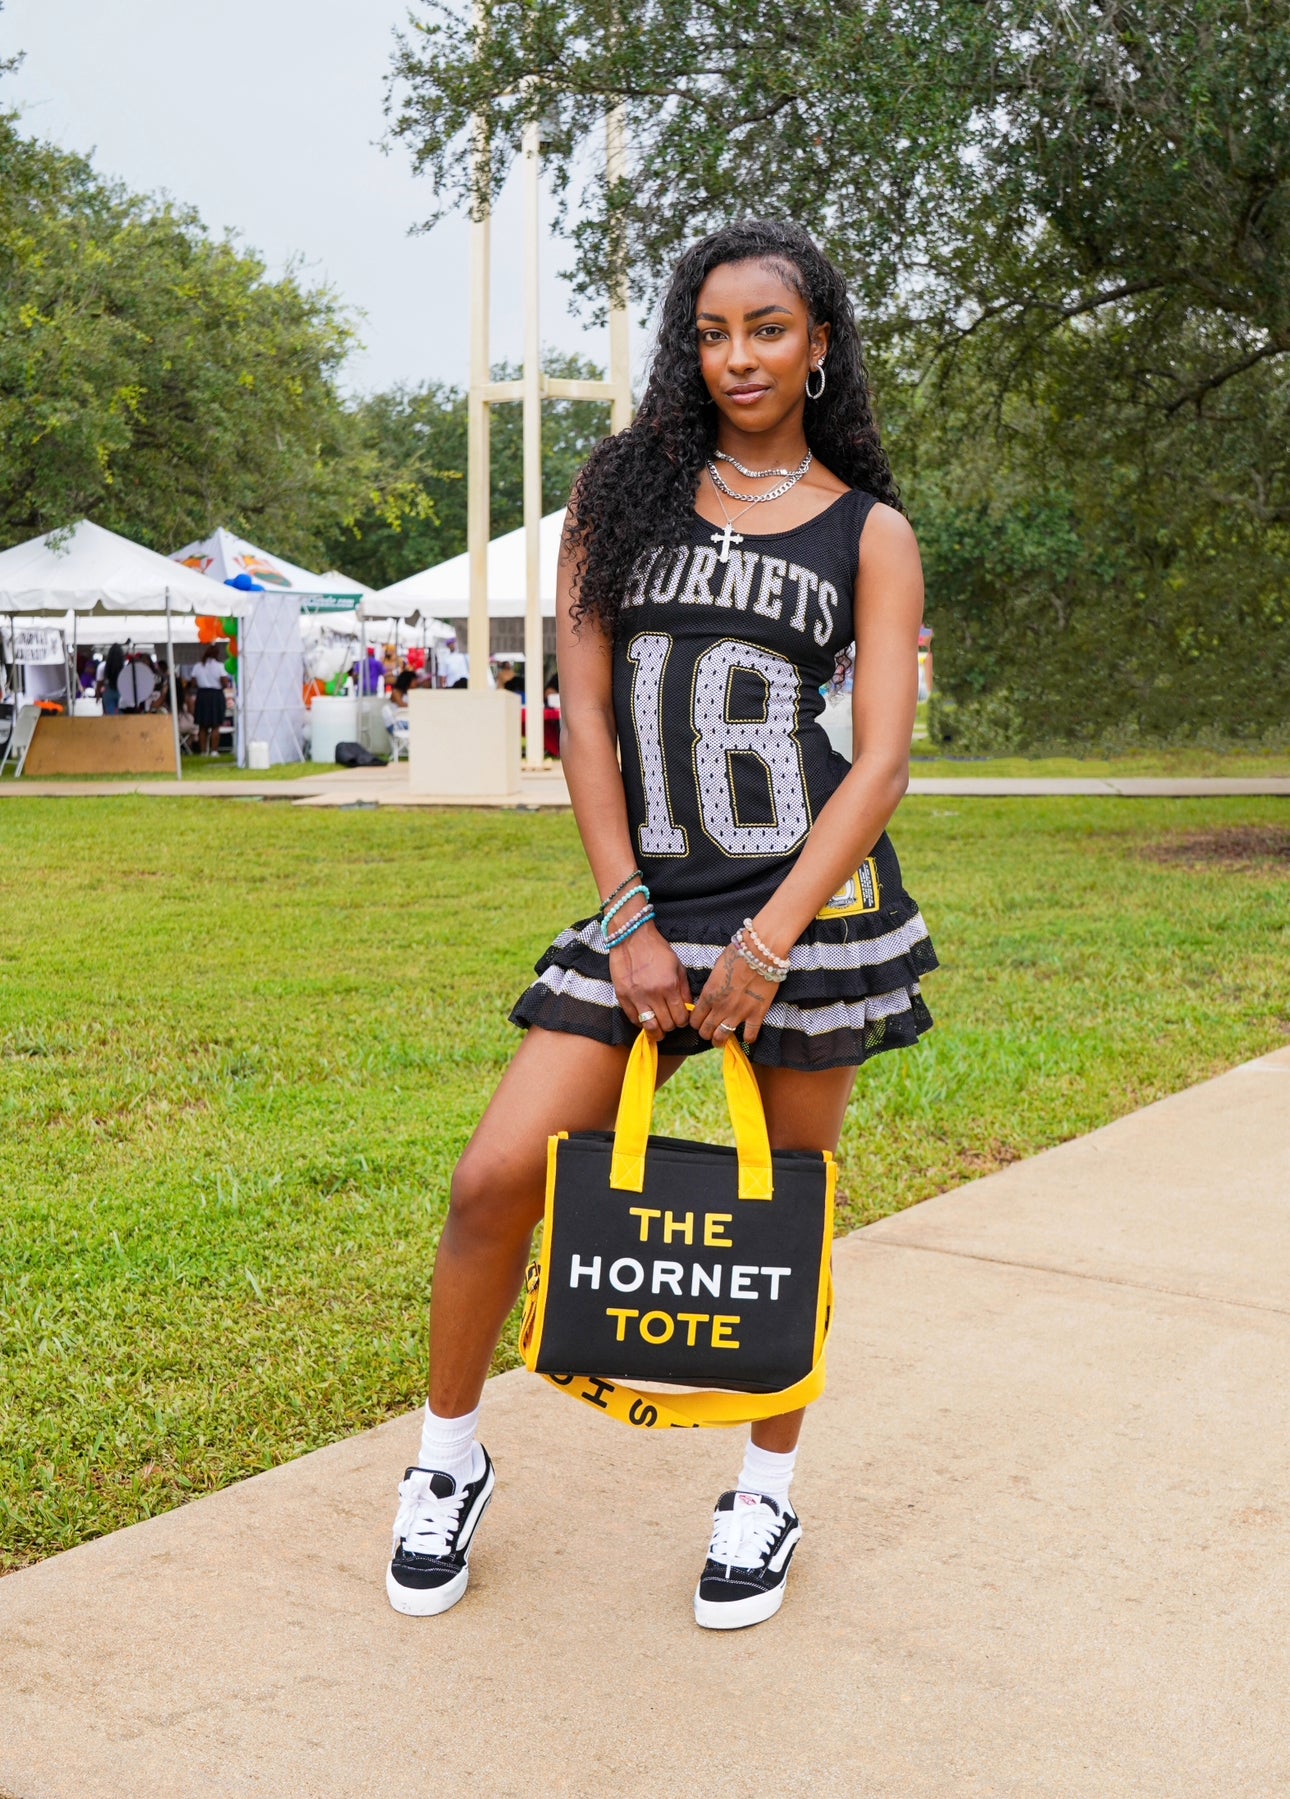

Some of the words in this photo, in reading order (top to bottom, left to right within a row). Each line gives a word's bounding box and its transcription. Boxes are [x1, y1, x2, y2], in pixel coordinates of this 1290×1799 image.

[627, 631, 812, 857] 18
[629, 1207, 733, 1247] THE
[569, 1254, 791, 1300] HORNET
[606, 1308, 741, 1349] TOTE
